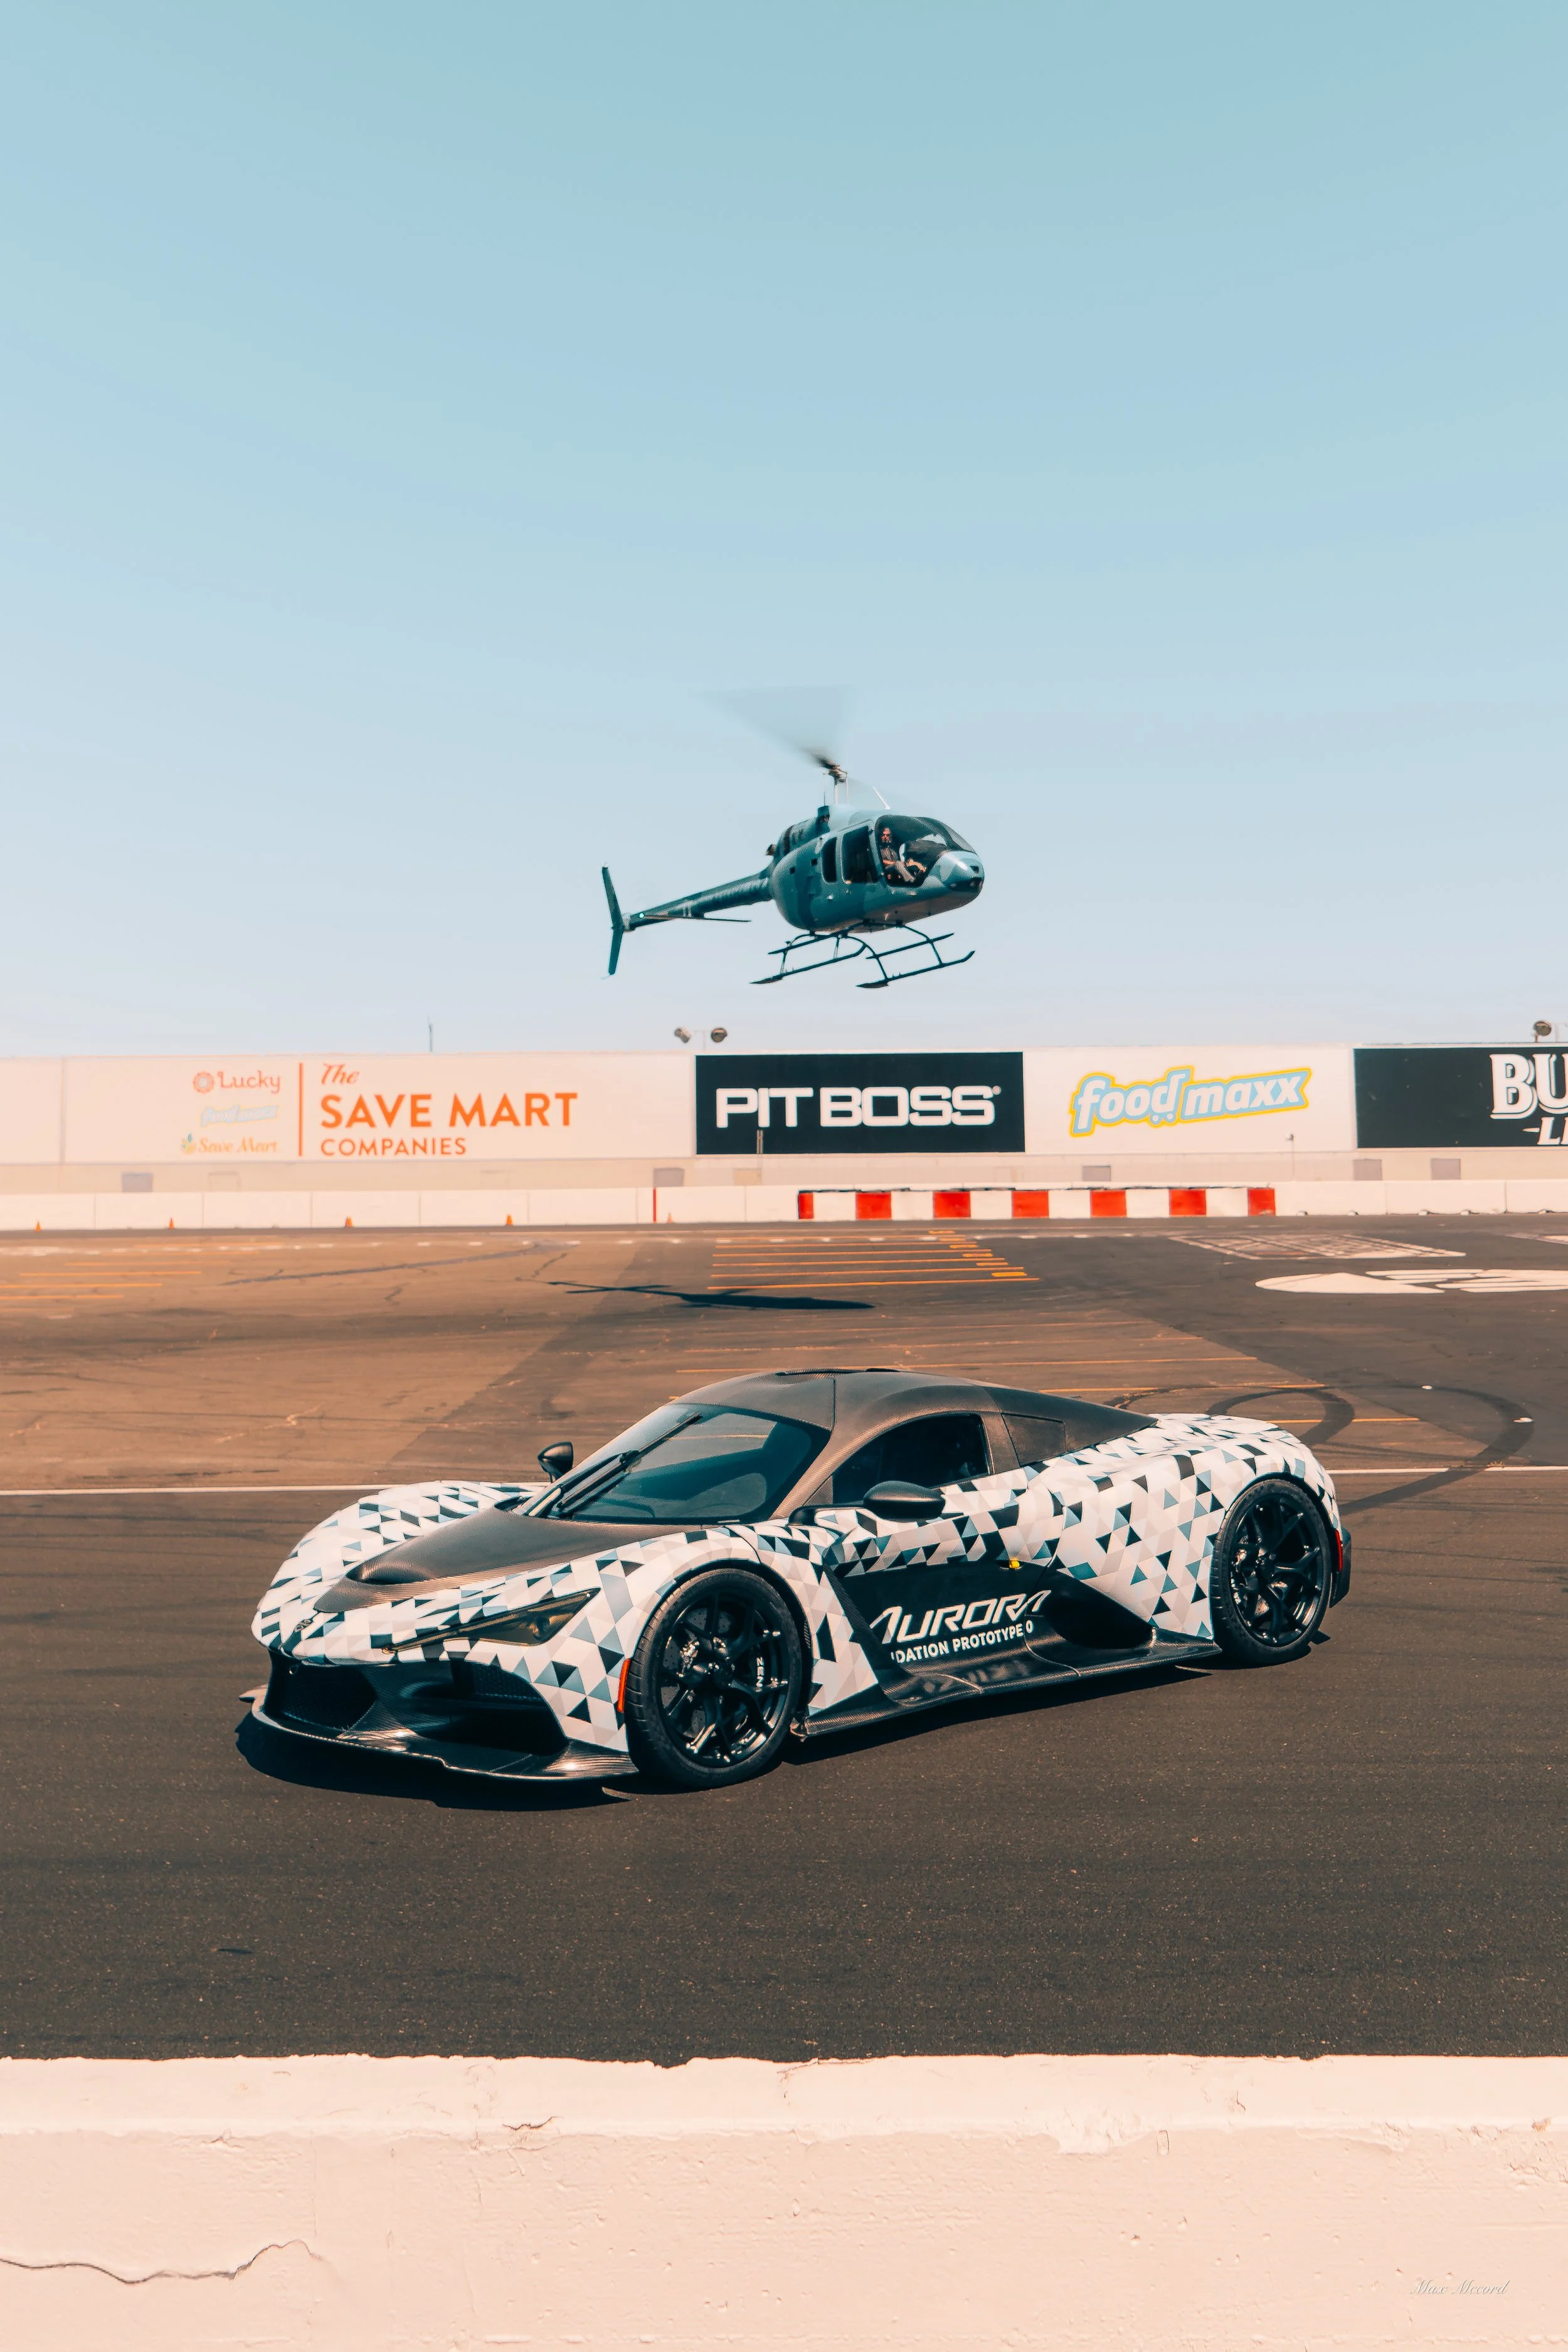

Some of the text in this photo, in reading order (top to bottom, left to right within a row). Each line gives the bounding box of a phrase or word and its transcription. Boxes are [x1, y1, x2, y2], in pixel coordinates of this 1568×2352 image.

[217, 1069, 281, 1094] Lucky
[320, 1063, 359, 1085] The
[320, 1093, 433, 1129] SAVE
[448, 1091, 578, 1128] MART
[716, 1085, 996, 1128] PIT BOSS
[199, 1136, 277, 1153] Save Mart
[320, 1136, 467, 1157] COMPANIES
[869, 1589, 1052, 1644] AURORA
[952, 1623, 1024, 1652] PROTOTYPE
